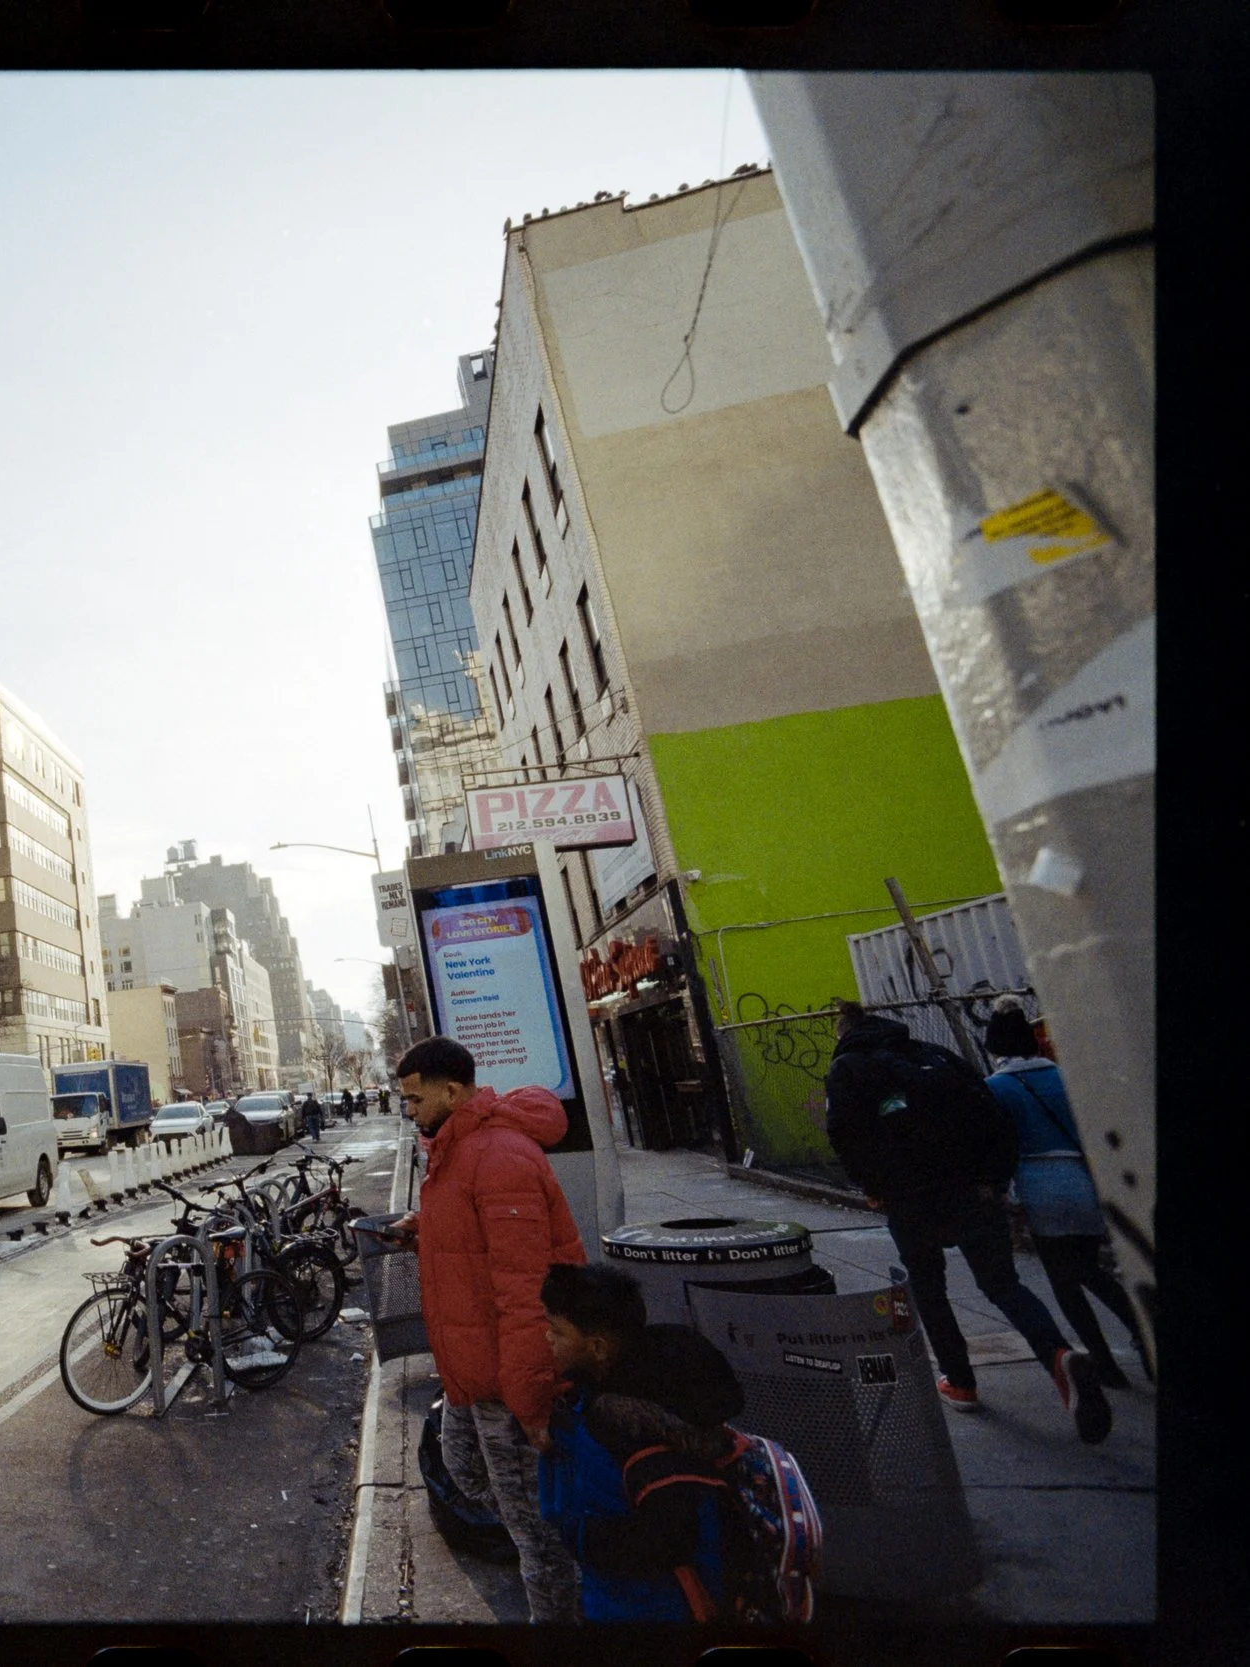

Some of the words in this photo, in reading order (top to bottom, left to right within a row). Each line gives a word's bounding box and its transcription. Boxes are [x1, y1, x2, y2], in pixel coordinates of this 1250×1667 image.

[475, 781, 618, 834] PIZZA
[497, 810, 622, 832] 212.594.8939
[484, 846, 532, 860] LinkNYC
[476, 915, 499, 925] CITY
[473, 923, 515, 936] STORIES
[445, 959, 467, 969] New
[468, 956, 491, 966] York
[447, 967, 495, 980] Valentine
[455, 1014, 478, 1022] Annie
[479, 1011, 502, 1020] lands
[502, 1009, 516, 1018] her
[456, 1022, 484, 1032] dream
[484, 1020, 497, 1031] job
[498, 1020, 506, 1028] in
[458, 1030, 503, 1041] Manhattan
[504, 1028, 520, 1036] and
[464, 1039, 486, 1050] rings
[486, 1038, 501, 1047] her
[501, 1037, 520, 1046] teen
[487, 1059, 497, 1068] go
[498, 1056, 528, 1067] wrong?
[623, 1247, 656, 1260] Don't
[662, 1249, 699, 1262] litter
[729, 1247, 768, 1261] Don't
[773, 1244, 800, 1257] litter
[776, 1333, 804, 1345] Put
